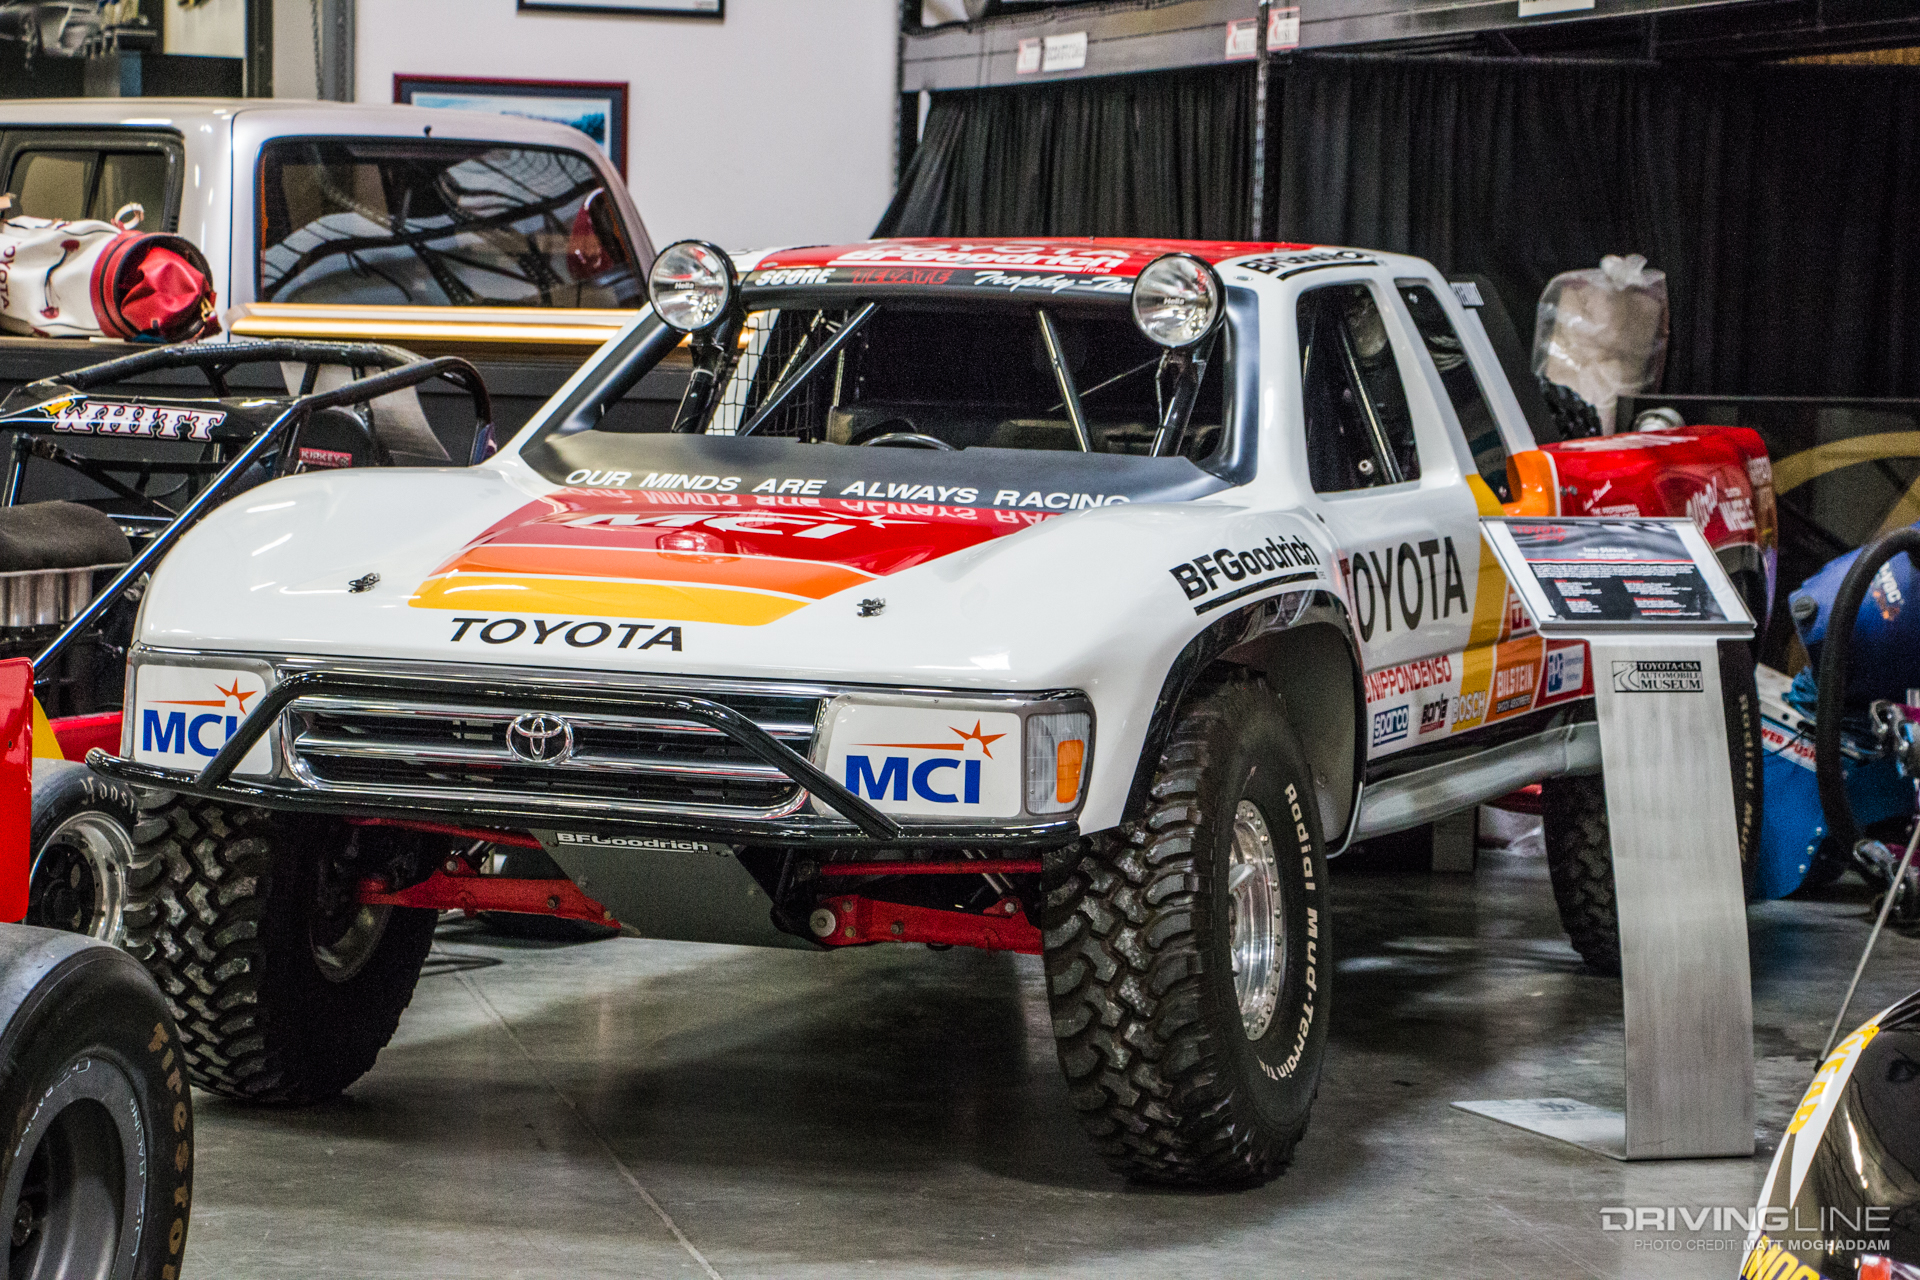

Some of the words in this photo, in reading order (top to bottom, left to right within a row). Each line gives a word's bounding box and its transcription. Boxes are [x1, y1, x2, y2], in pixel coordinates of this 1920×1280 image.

[0, 241, 17, 309] OYOTA
[836, 250, 1126, 267] BFGoodrich
[674, 282, 695, 290] Hella
[754, 268, 836, 286] SCORE
[850, 269, 955, 285] TECATE
[1163, 296, 1185, 305] Hella
[52, 401, 227, 440] WHITT
[301, 450, 340, 461] KIRKEY
[565, 469, 632, 486] OUR
[639, 473, 741, 491] MINDS
[751, 478, 827, 494] ARE
[840, 480, 979, 503] ALWAYS
[993, 490, 1130, 509] RACING
[1512, 525, 1566, 534] TOYOTA
[1169, 535, 1320, 601] BFGoodrich
[1339, 536, 1468, 643] TOYOTA
[451, 617, 683, 652] TOYOTA
[1369, 656, 1452, 702] NIPPONDENSO
[1497, 663, 1534, 698] BILSTEIN
[1640, 672, 1701, 680] AUTOMOBILE
[1641, 680, 1701, 689] MUSEUM
[1374, 707, 1408, 737] sparco
[1453, 690, 1485, 724] BOSCH
[143, 709, 238, 757] MCI
[846, 755, 981, 804] MCI
[557, 832, 708, 851] BFGoodrich
[1285, 783, 1316, 891] Radial
